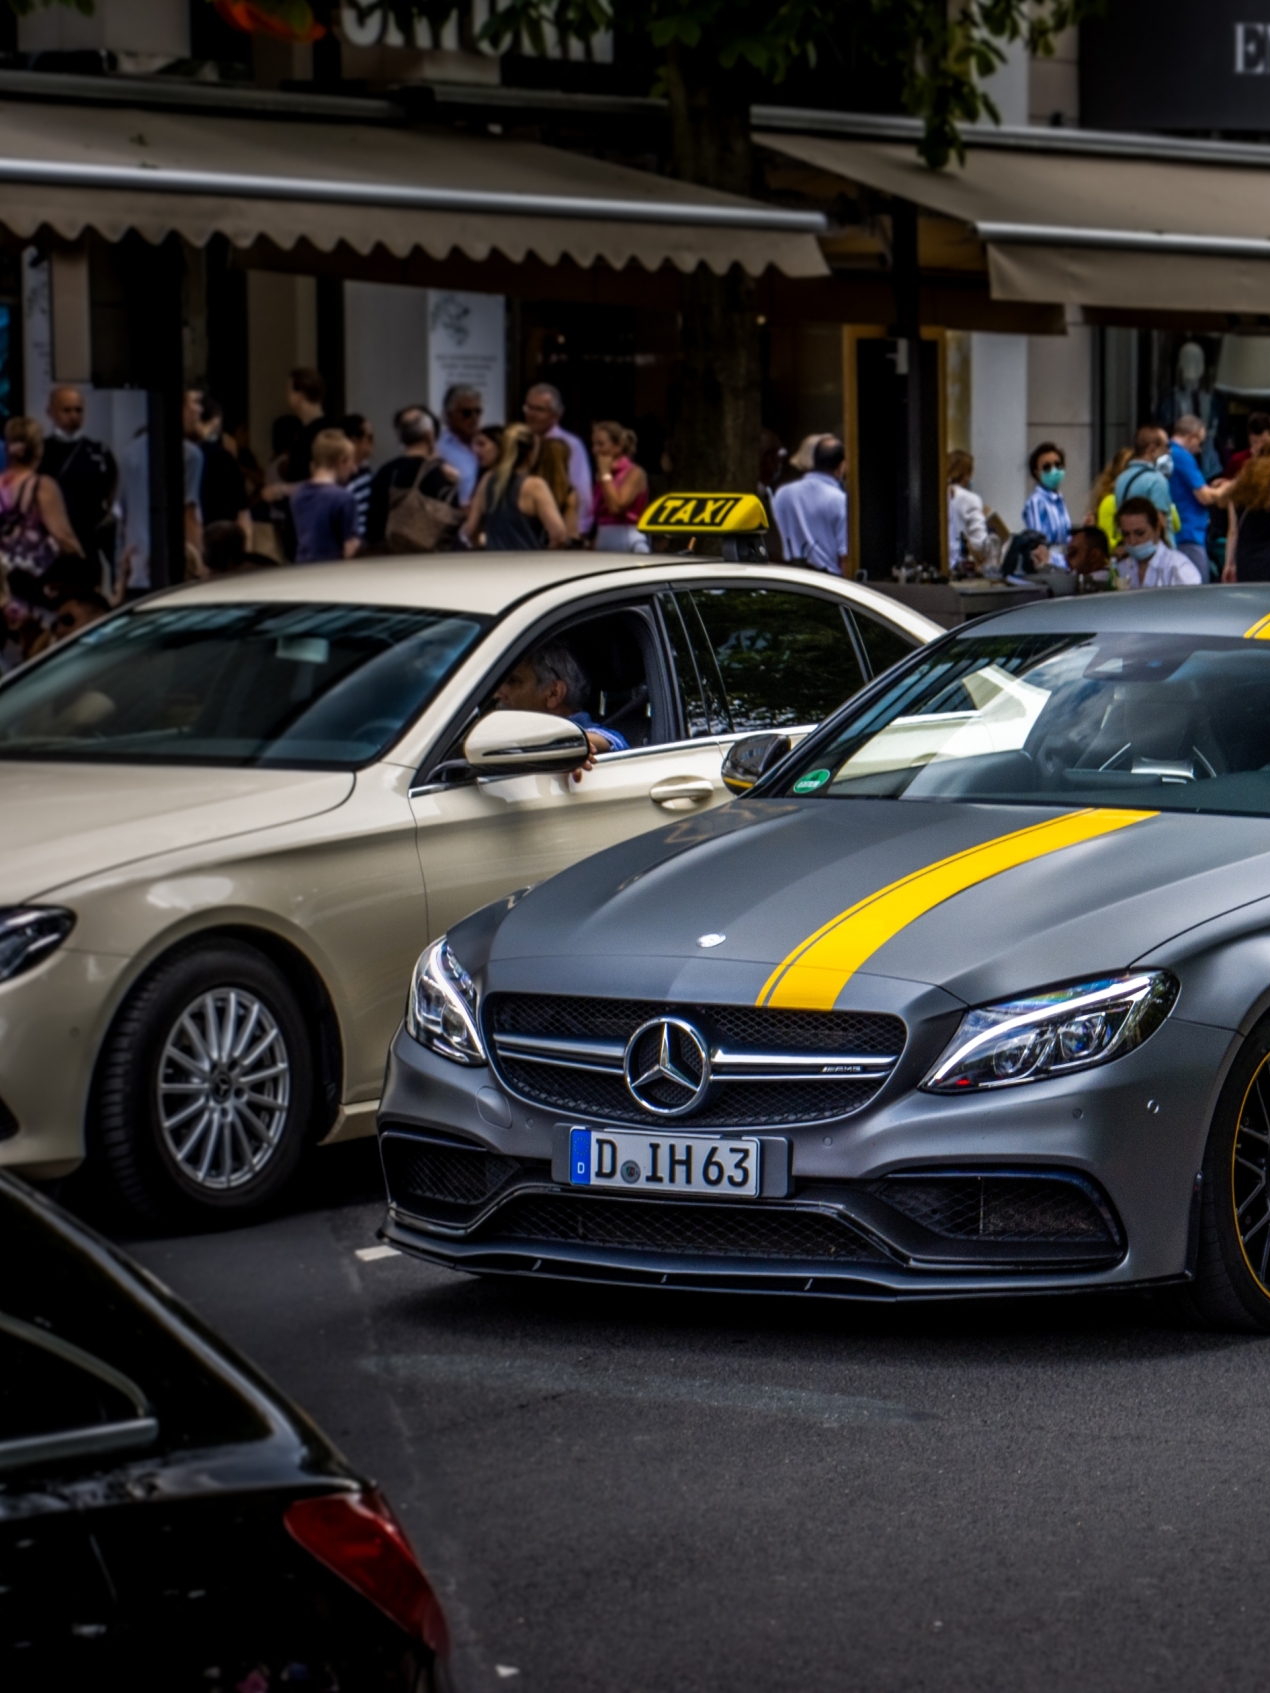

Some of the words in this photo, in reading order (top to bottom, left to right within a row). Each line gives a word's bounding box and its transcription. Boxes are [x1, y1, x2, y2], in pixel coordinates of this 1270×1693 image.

[658, 500, 735, 523] TAXI
[577, 1161, 585, 1174] D
[595, 1138, 617, 1179] D
[645, 1142, 692, 1184] IH
[702, 1146, 750, 1187] 63
